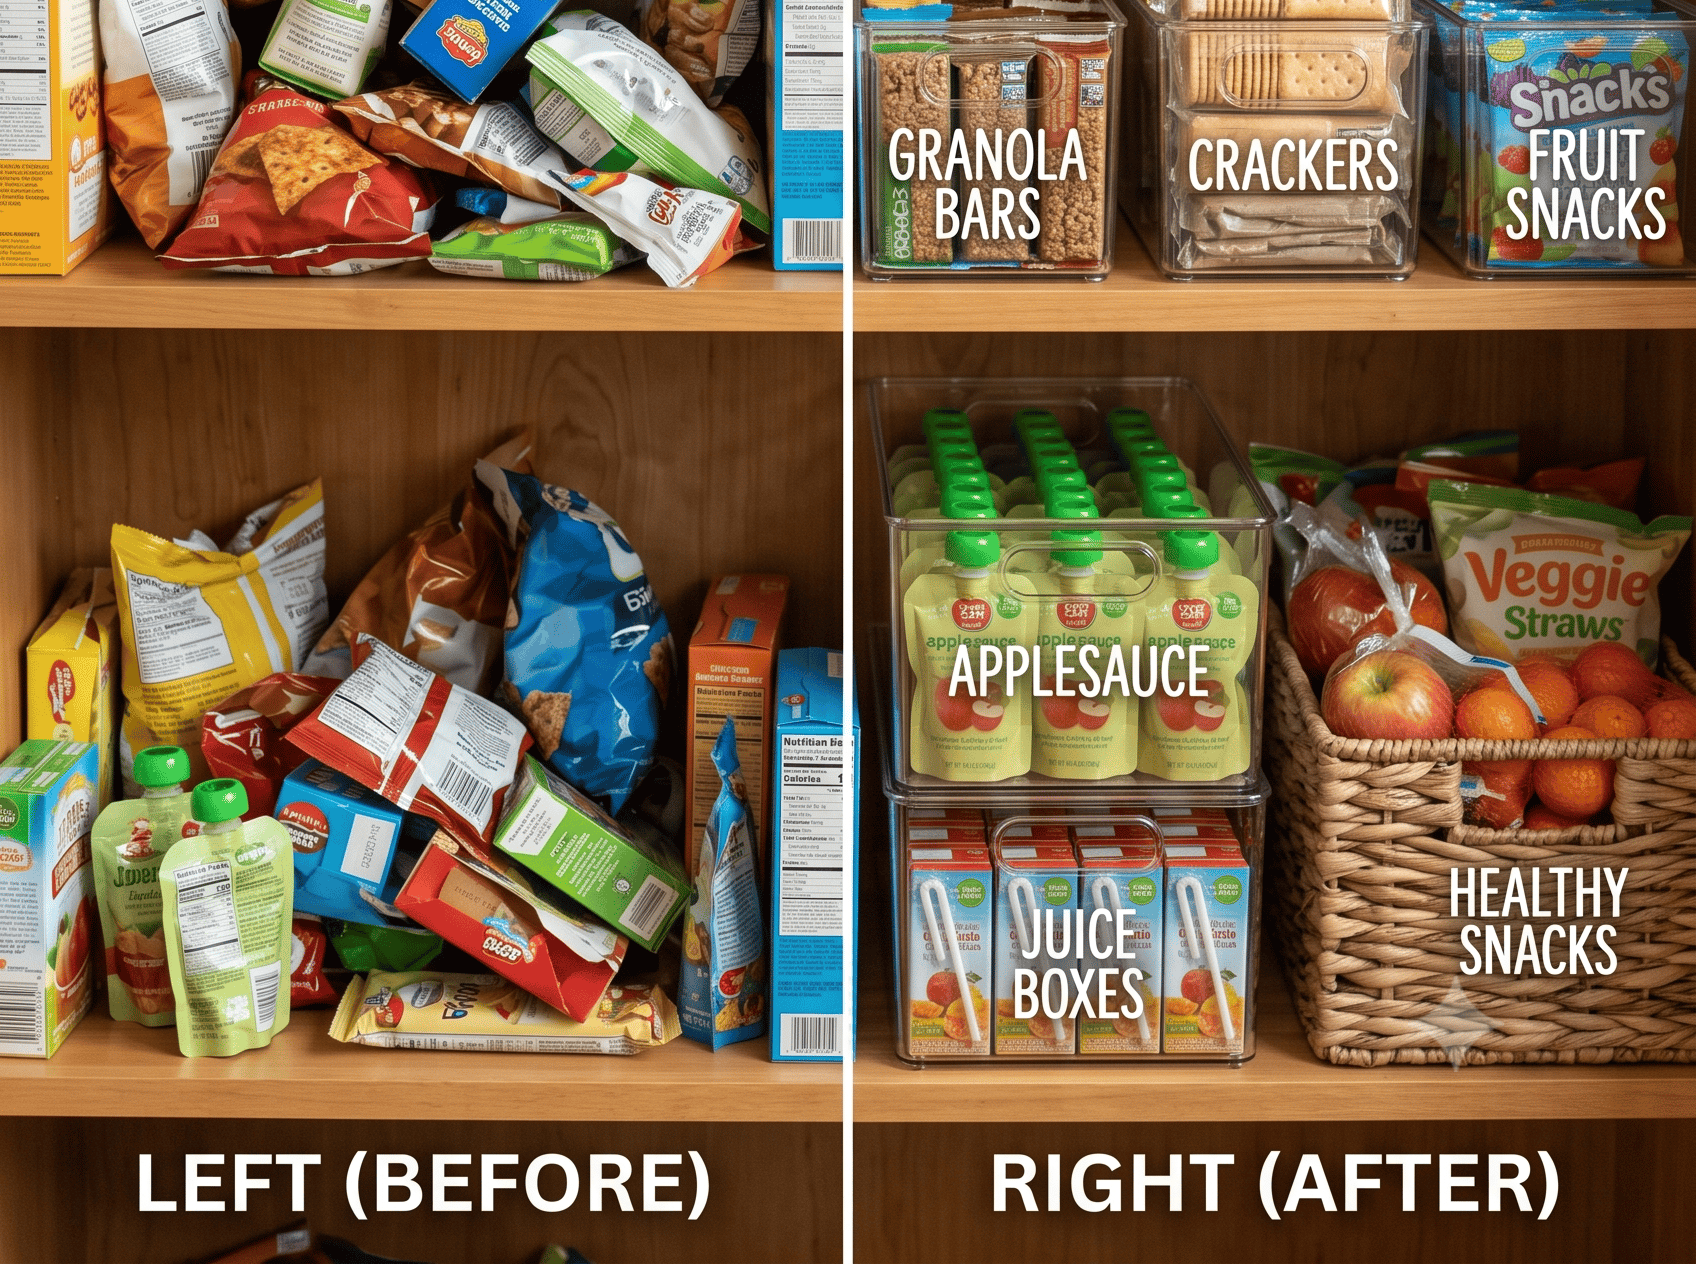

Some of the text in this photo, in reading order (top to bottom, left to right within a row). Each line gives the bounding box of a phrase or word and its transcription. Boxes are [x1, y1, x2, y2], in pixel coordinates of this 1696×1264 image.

[1510, 68, 1671, 129] Snacks
[1463, 547, 1651, 610] Veggie
[1504, 605, 1625, 642] Straws
